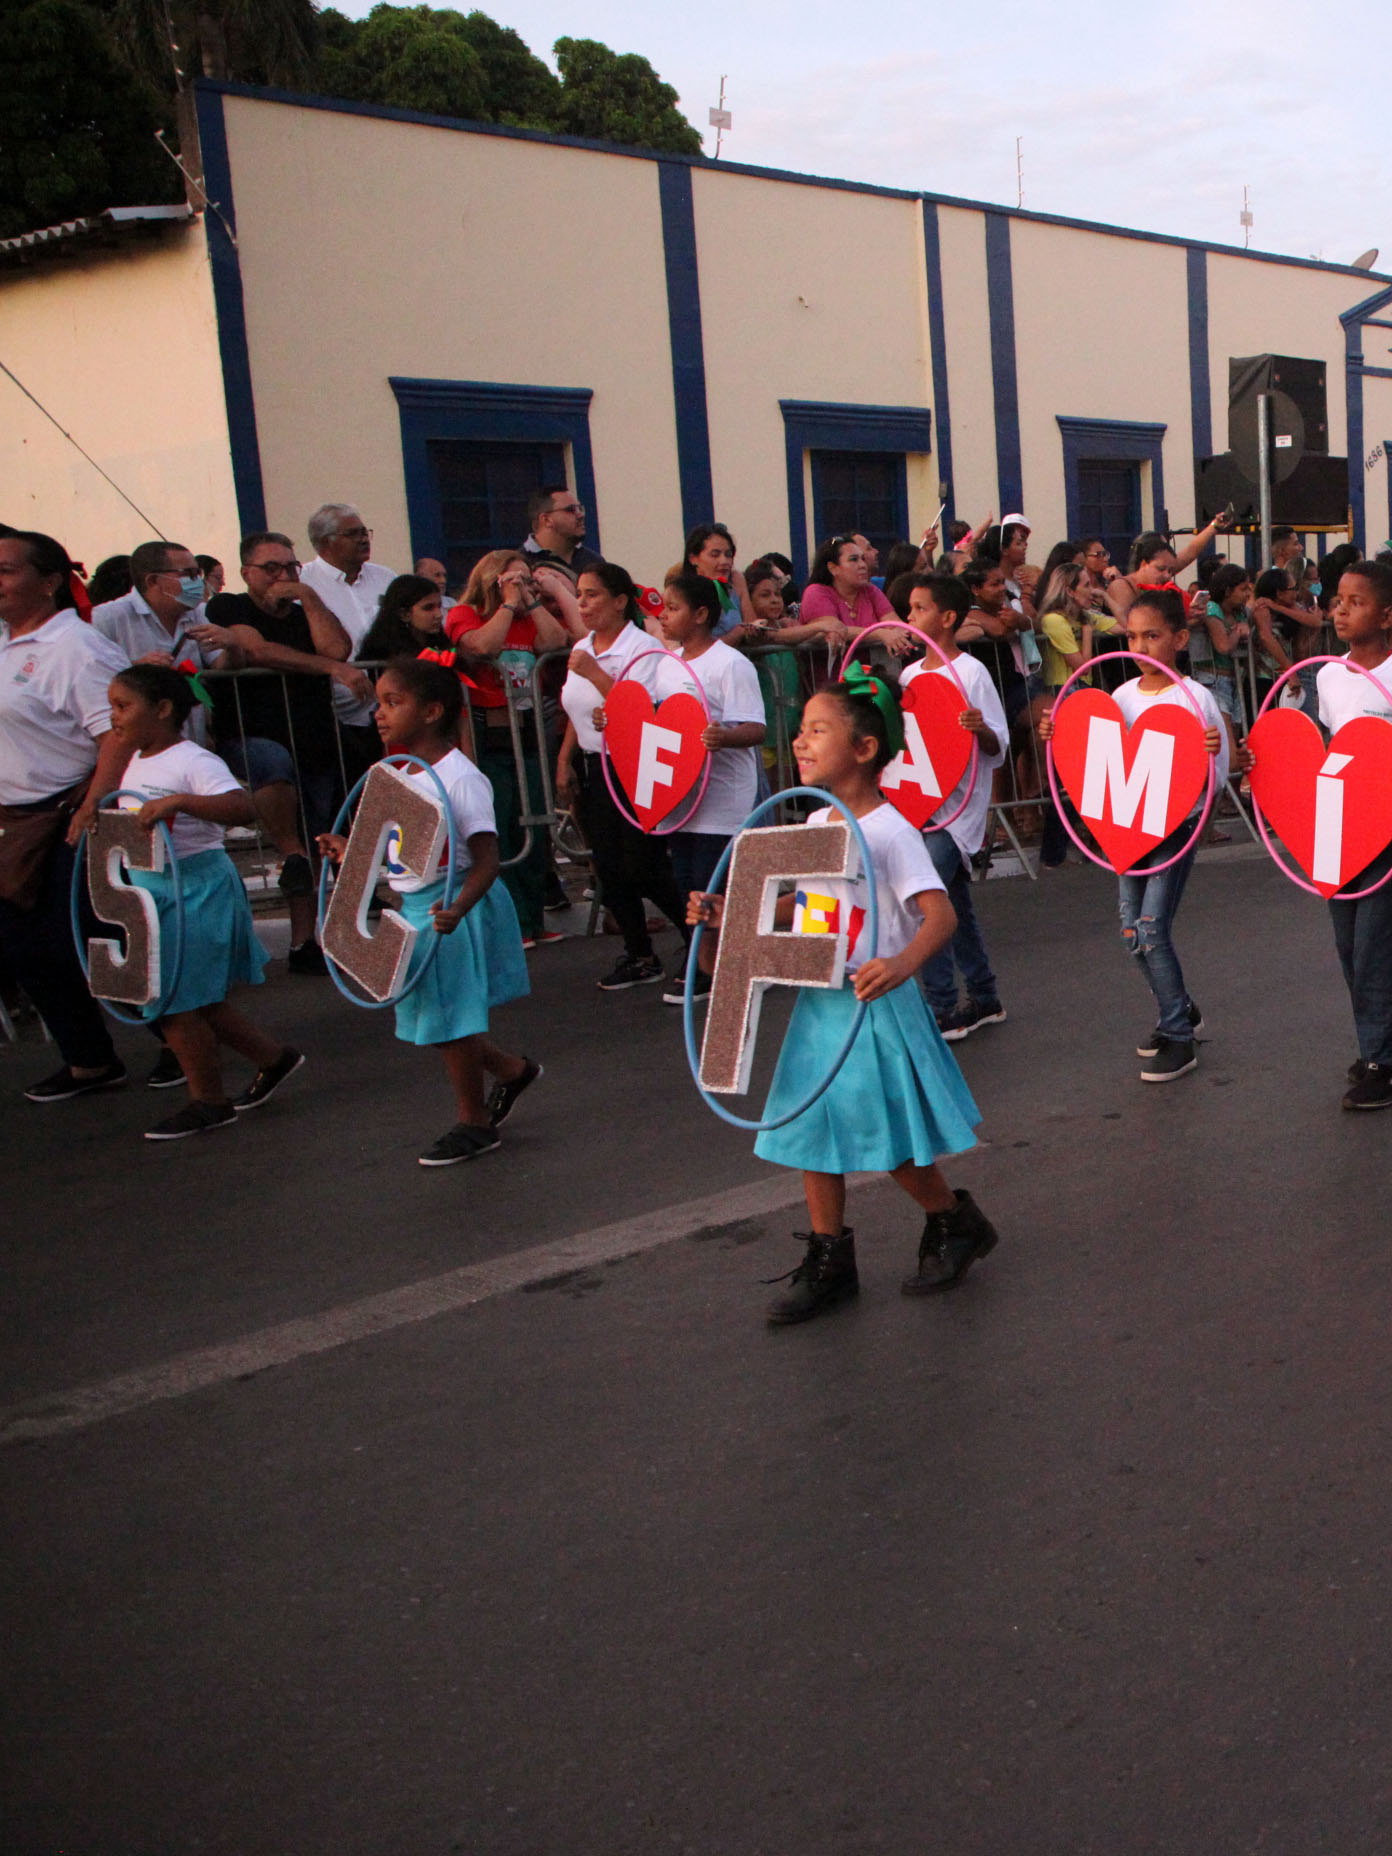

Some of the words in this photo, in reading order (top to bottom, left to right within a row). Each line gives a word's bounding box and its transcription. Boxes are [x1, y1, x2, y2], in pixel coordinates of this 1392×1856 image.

[634, 721, 682, 810] F
[880, 711, 943, 798] A
[1080, 715, 1176, 838] M
[88, 807, 164, 1004] S
[321, 761, 447, 1001] C
[700, 820, 858, 1095] F
